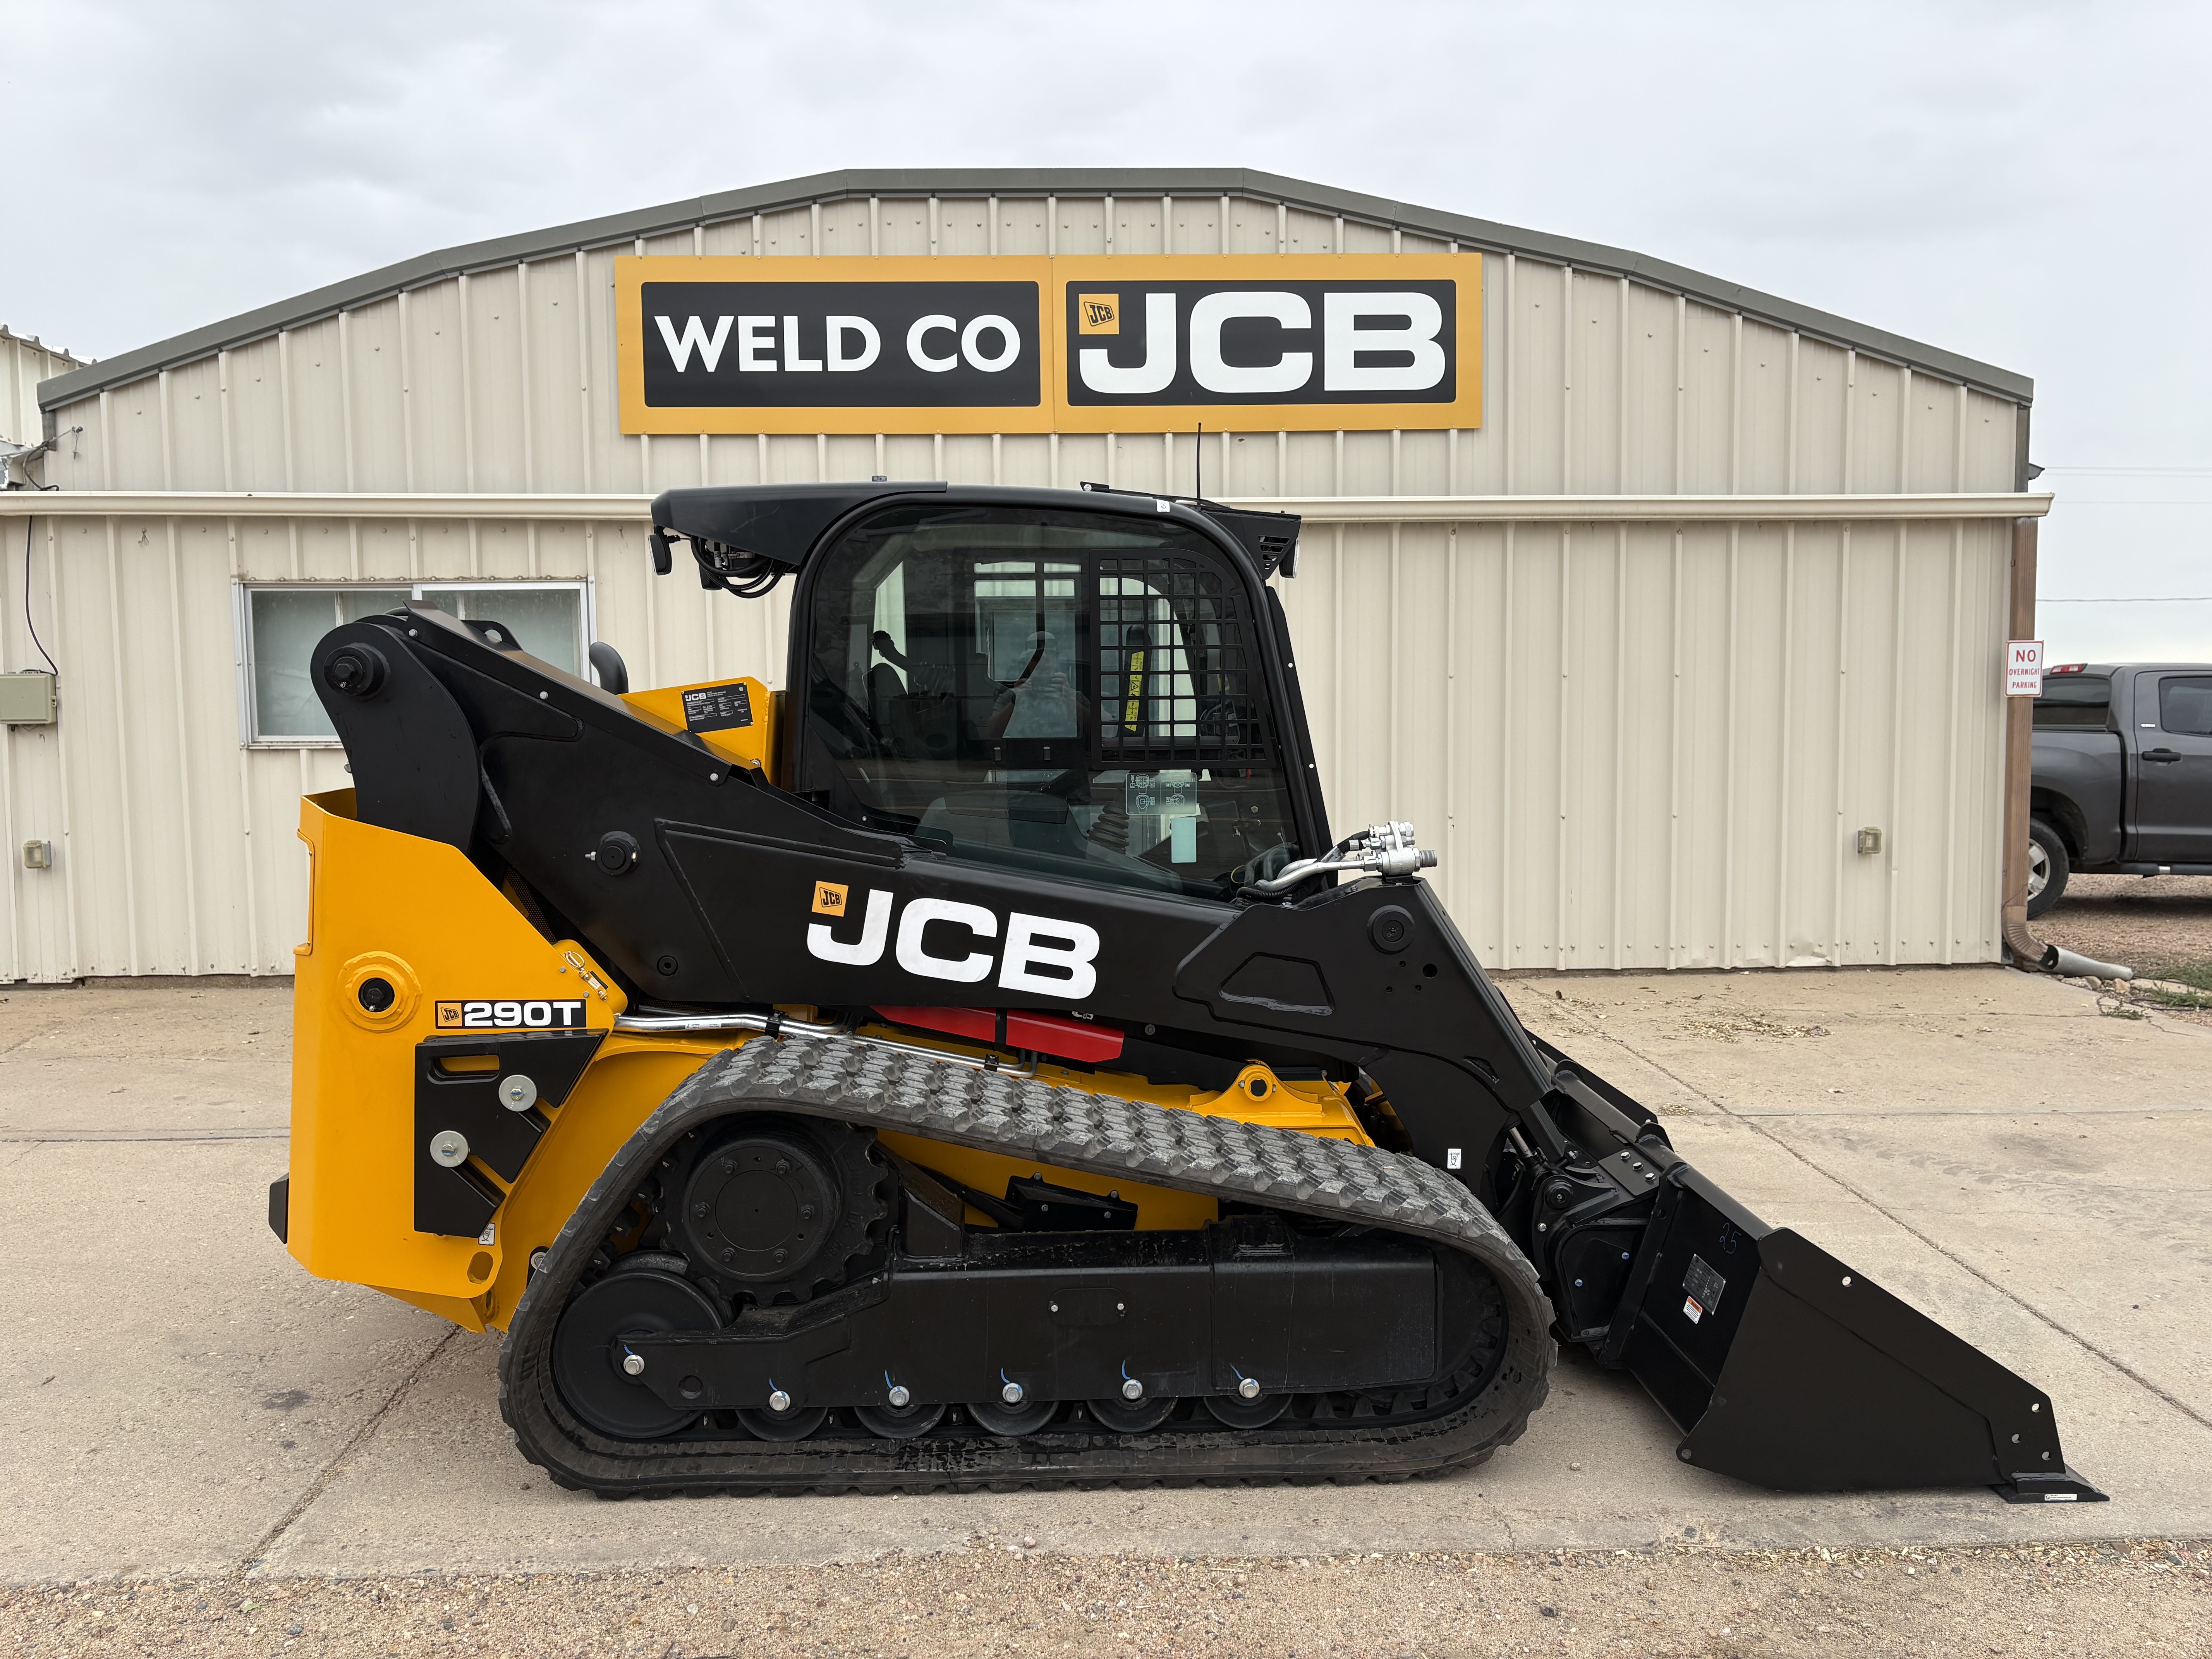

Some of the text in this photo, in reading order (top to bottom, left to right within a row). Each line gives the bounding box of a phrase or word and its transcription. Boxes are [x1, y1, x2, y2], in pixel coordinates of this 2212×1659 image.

[1089, 304, 1112, 324] JCB
[654, 314, 1021, 373] WELD CO
[1079, 291, 1445, 394] JCB
[2016, 649, 2036, 662] NO
[685, 692, 707, 701] JCB
[822, 890, 840, 905] JCB
[807, 889, 1100, 1000] JCB
[443, 1001, 581, 1026] JCB 290T
